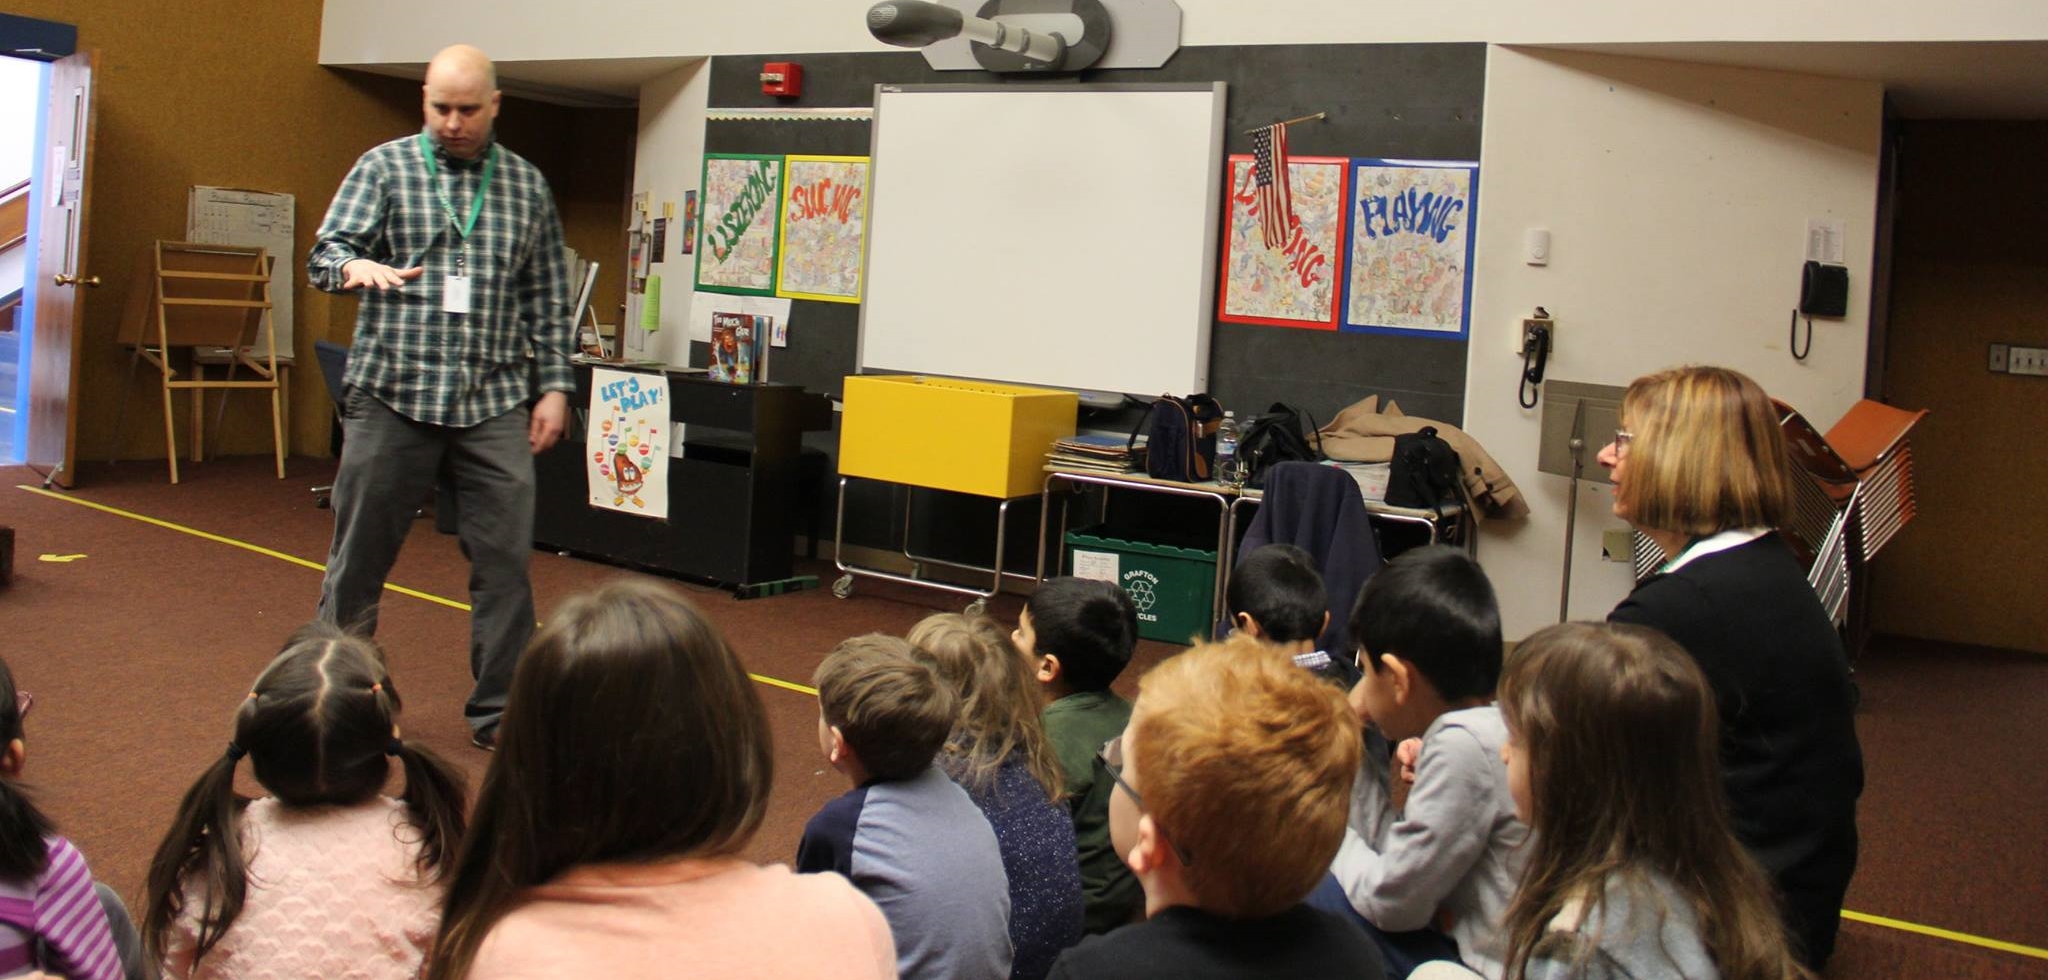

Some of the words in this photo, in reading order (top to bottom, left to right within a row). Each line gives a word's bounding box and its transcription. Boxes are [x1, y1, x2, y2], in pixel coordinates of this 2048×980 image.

[601, 377, 639, 402] LET'S
[620, 386, 663, 413] PLAY!
[1123, 570, 1159, 585] GRAFTON
